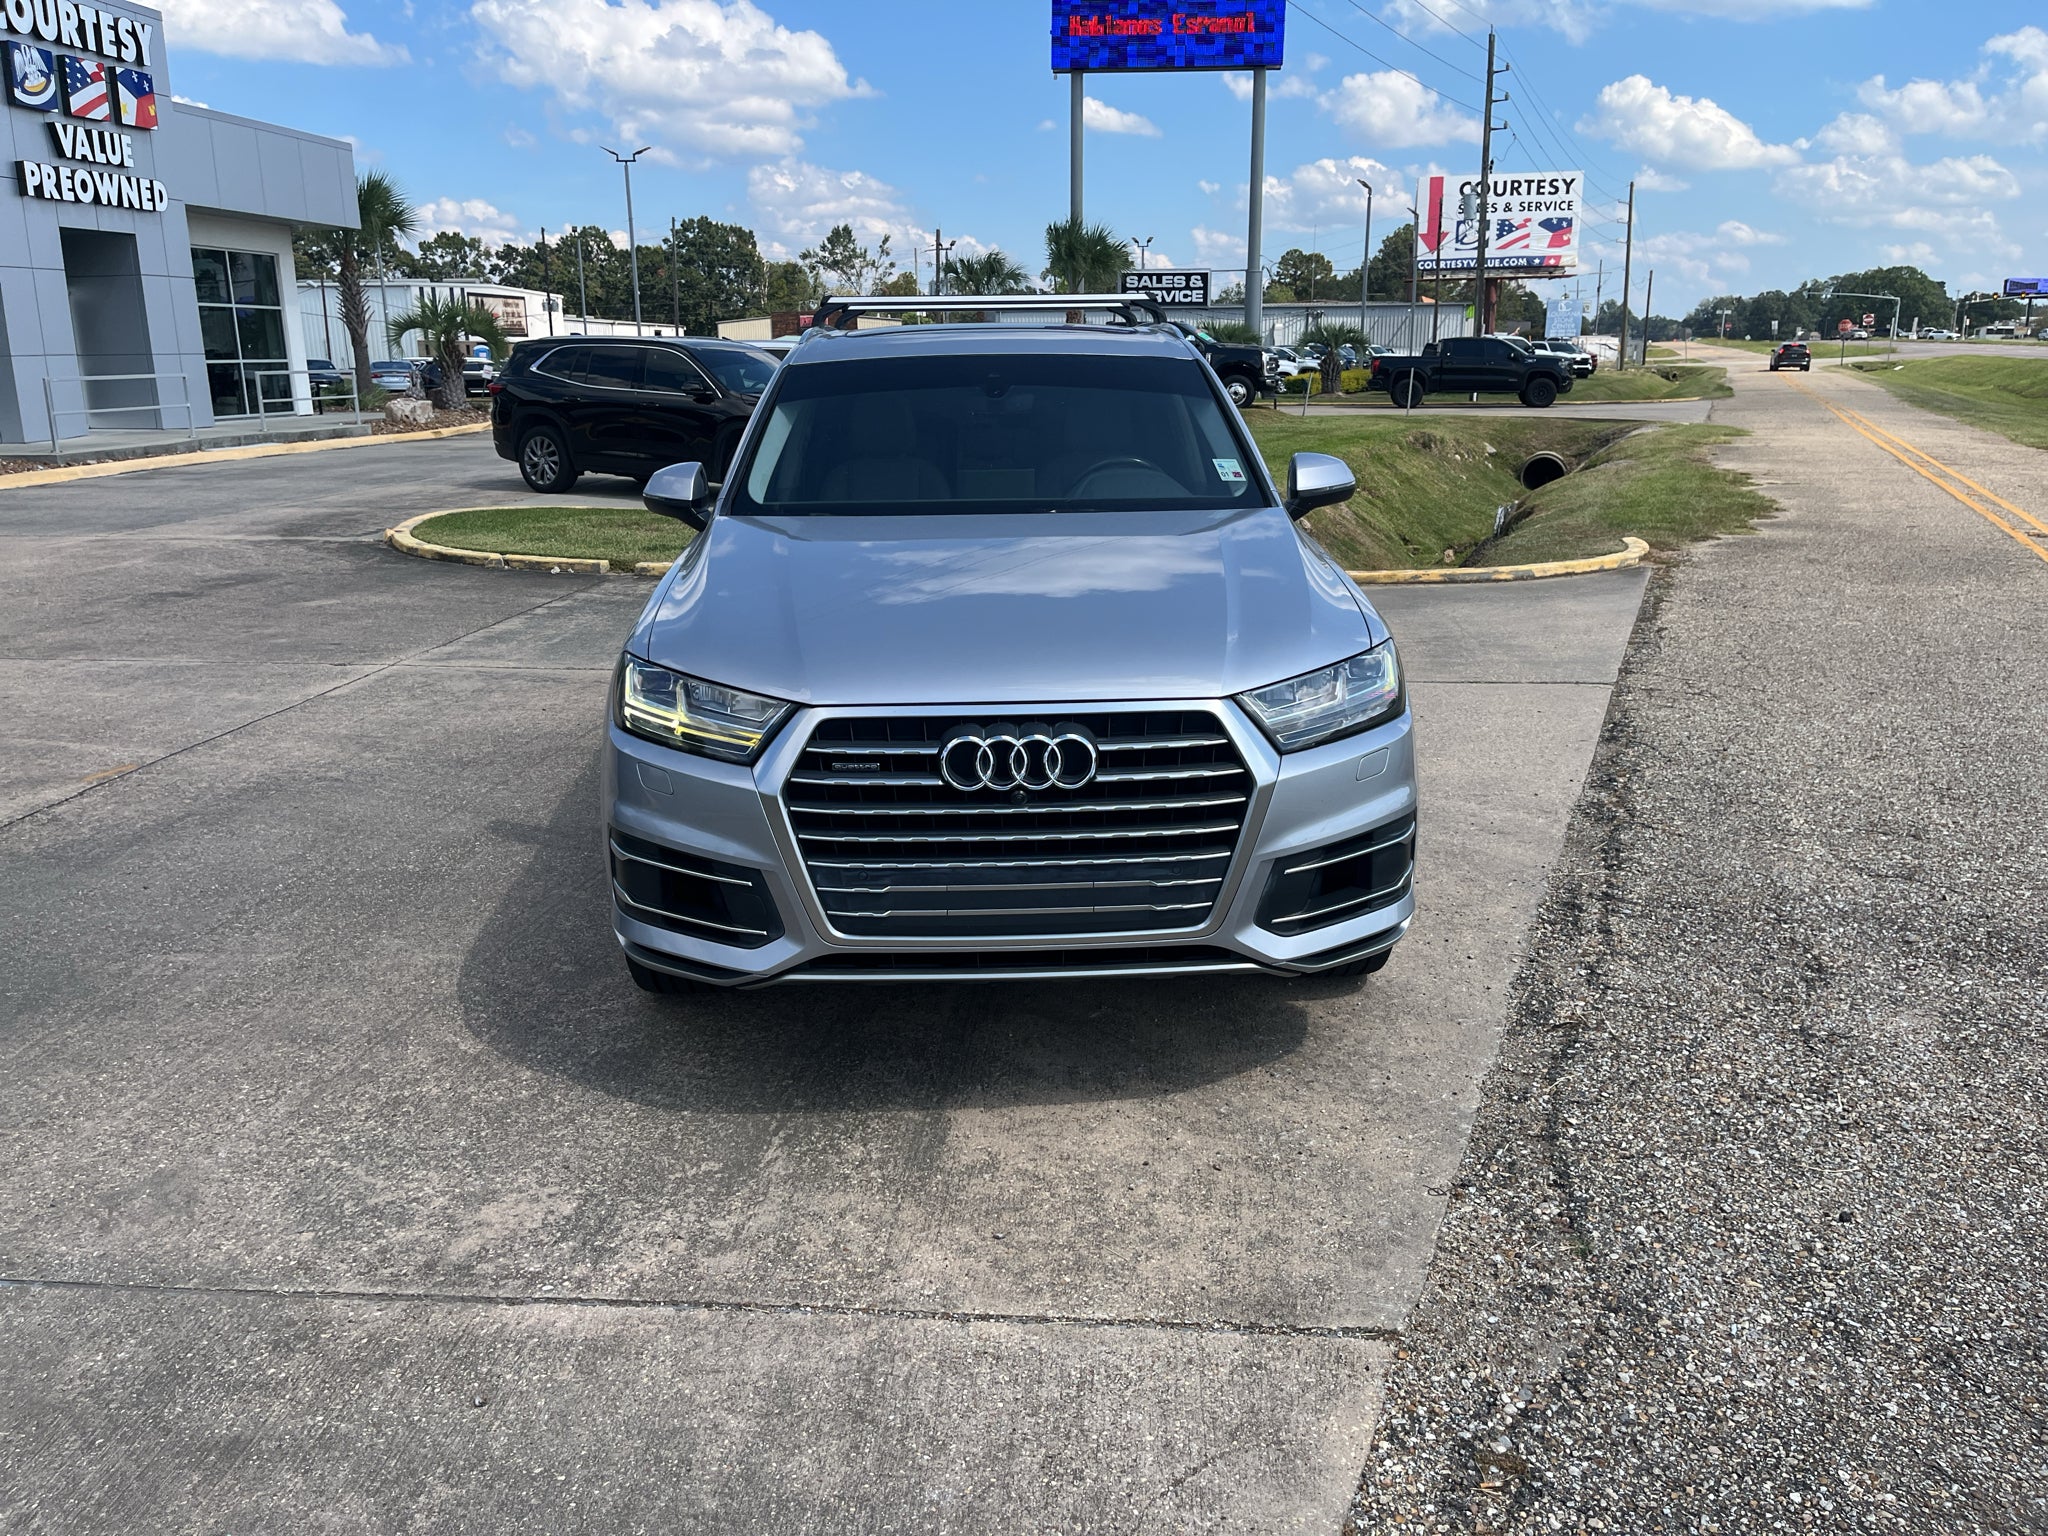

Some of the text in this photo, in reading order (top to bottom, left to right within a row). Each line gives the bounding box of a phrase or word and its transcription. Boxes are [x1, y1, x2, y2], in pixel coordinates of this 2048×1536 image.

[54, 122, 135, 168] VALUE
[24, 161, 169, 212] PREOWNED
[1503, 202, 1513, 212] &
[1519, 201, 1574, 212] SERVICE
[1126, 275, 1204, 288] SALES &
[1126, 290, 1204, 303] RVICE
